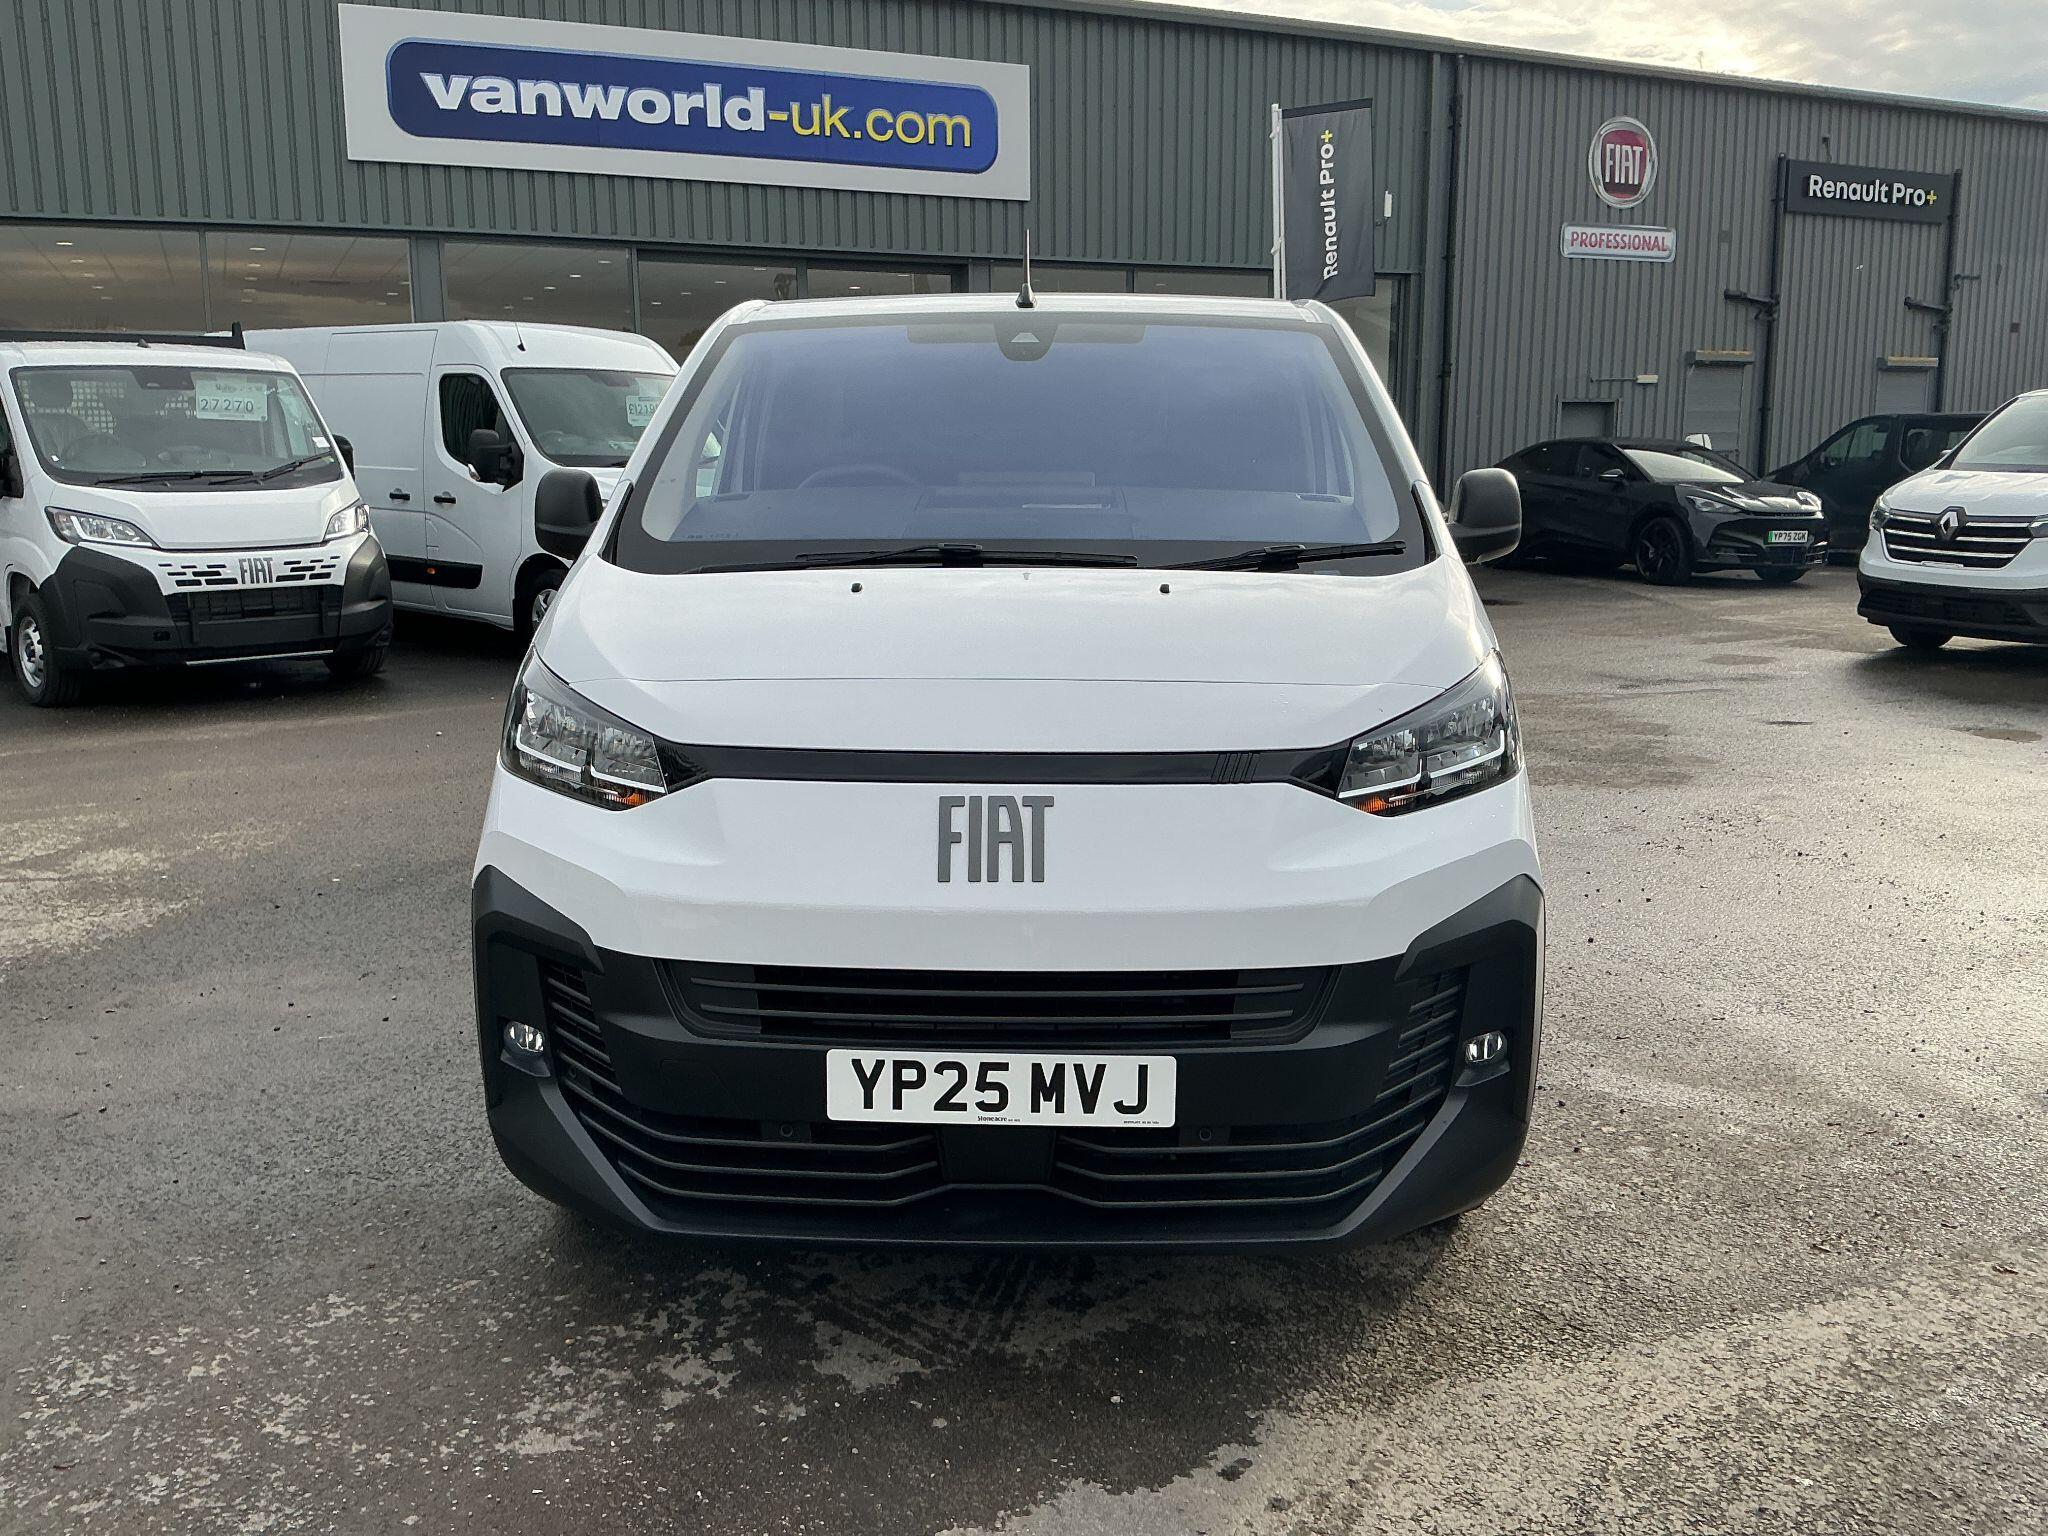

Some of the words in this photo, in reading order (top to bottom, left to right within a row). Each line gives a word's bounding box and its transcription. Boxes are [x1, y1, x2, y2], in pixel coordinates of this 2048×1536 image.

[420, 72, 971, 147] vanworld-uk.com
[1605, 143, 1643, 184] FIAT
[1809, 174, 1889, 203] Renault
[1892, 182, 1937, 206] Pro+
[1320, 188, 1338, 280] Renault
[1570, 231, 1669, 251] PROFESSIONAL
[239, 557, 273, 584] FIAT
[938, 796, 1054, 882] FIAT
[851, 1058, 1009, 1112] YP25
[1030, 1062, 1149, 1115] MVJ
